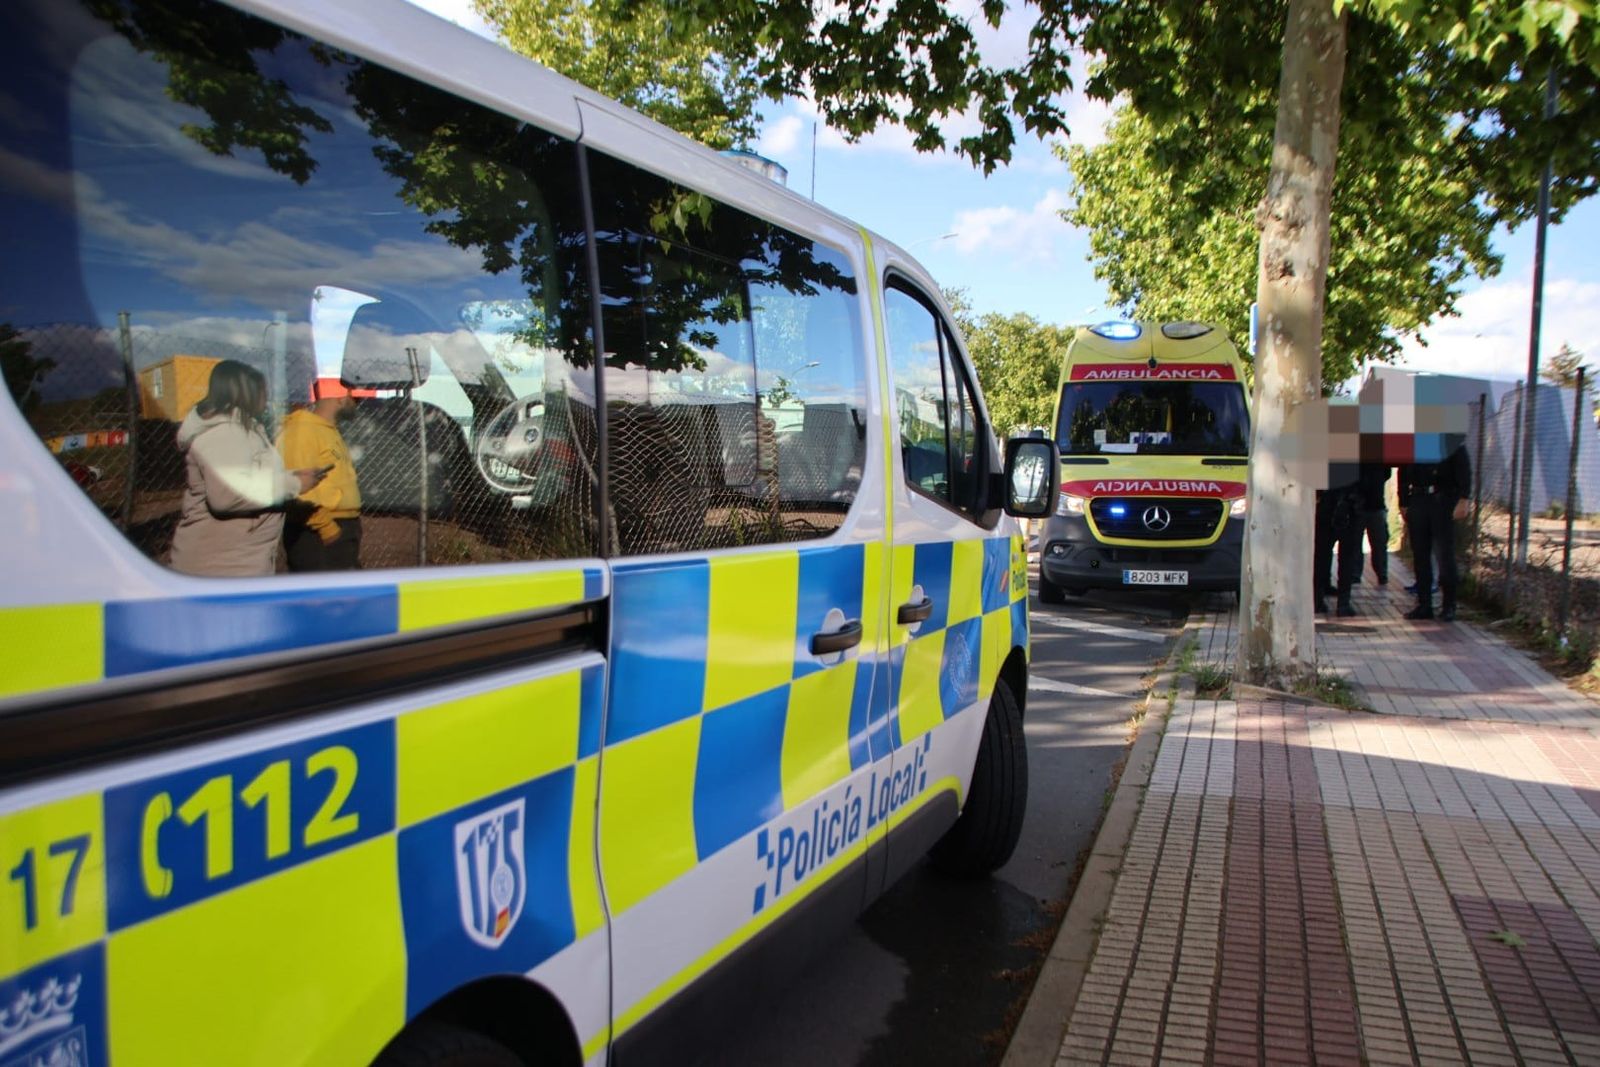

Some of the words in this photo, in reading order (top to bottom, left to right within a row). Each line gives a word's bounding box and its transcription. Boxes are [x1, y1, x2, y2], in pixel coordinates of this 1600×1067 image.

[1084, 369, 1222, 379] AMBULANCIA
[1131, 571, 1160, 583] 8203
[1163, 572, 1186, 583] MFK
[176, 745, 359, 880] 112
[775, 785, 862, 897] Policía
[866, 747, 919, 829] Local
[9, 832, 92, 933] 17
